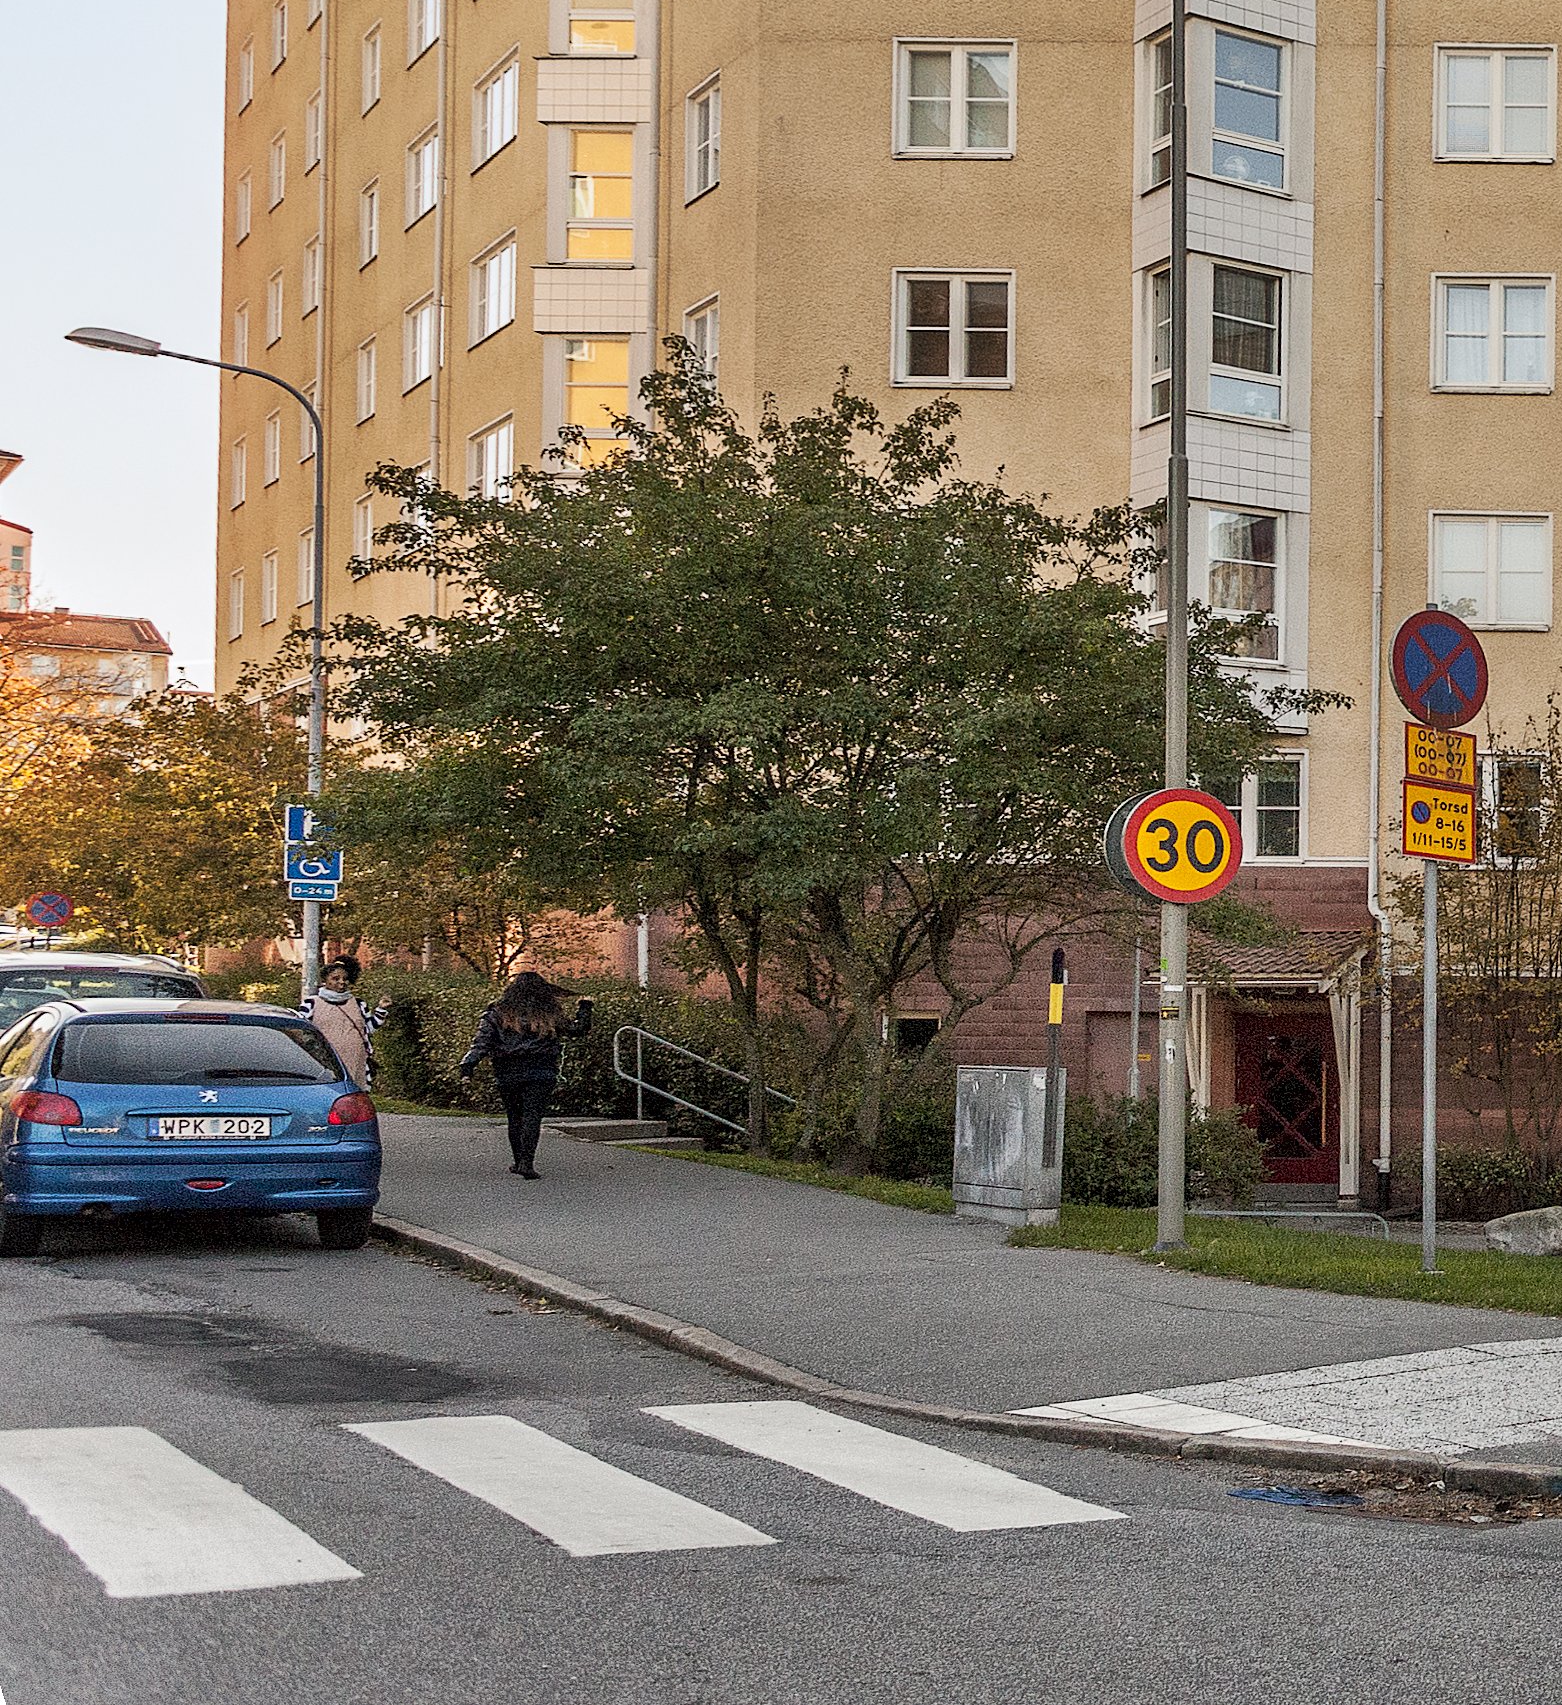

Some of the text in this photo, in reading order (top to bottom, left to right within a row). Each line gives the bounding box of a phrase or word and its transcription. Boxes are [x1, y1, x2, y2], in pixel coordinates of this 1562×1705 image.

[1418, 730, 1462, 749] 00-07
[1414, 744, 1467, 766] (00-07)
[1418, 761, 1463, 781] 00-07
[1433, 798, 1468, 814] Torsd
[1435, 817, 1465, 833] 8-16
[1146, 818, 1224, 873] 30
[1412, 832, 1467, 851] 1/11-15/5
[163, 1119, 266, 1135] WPK 202
